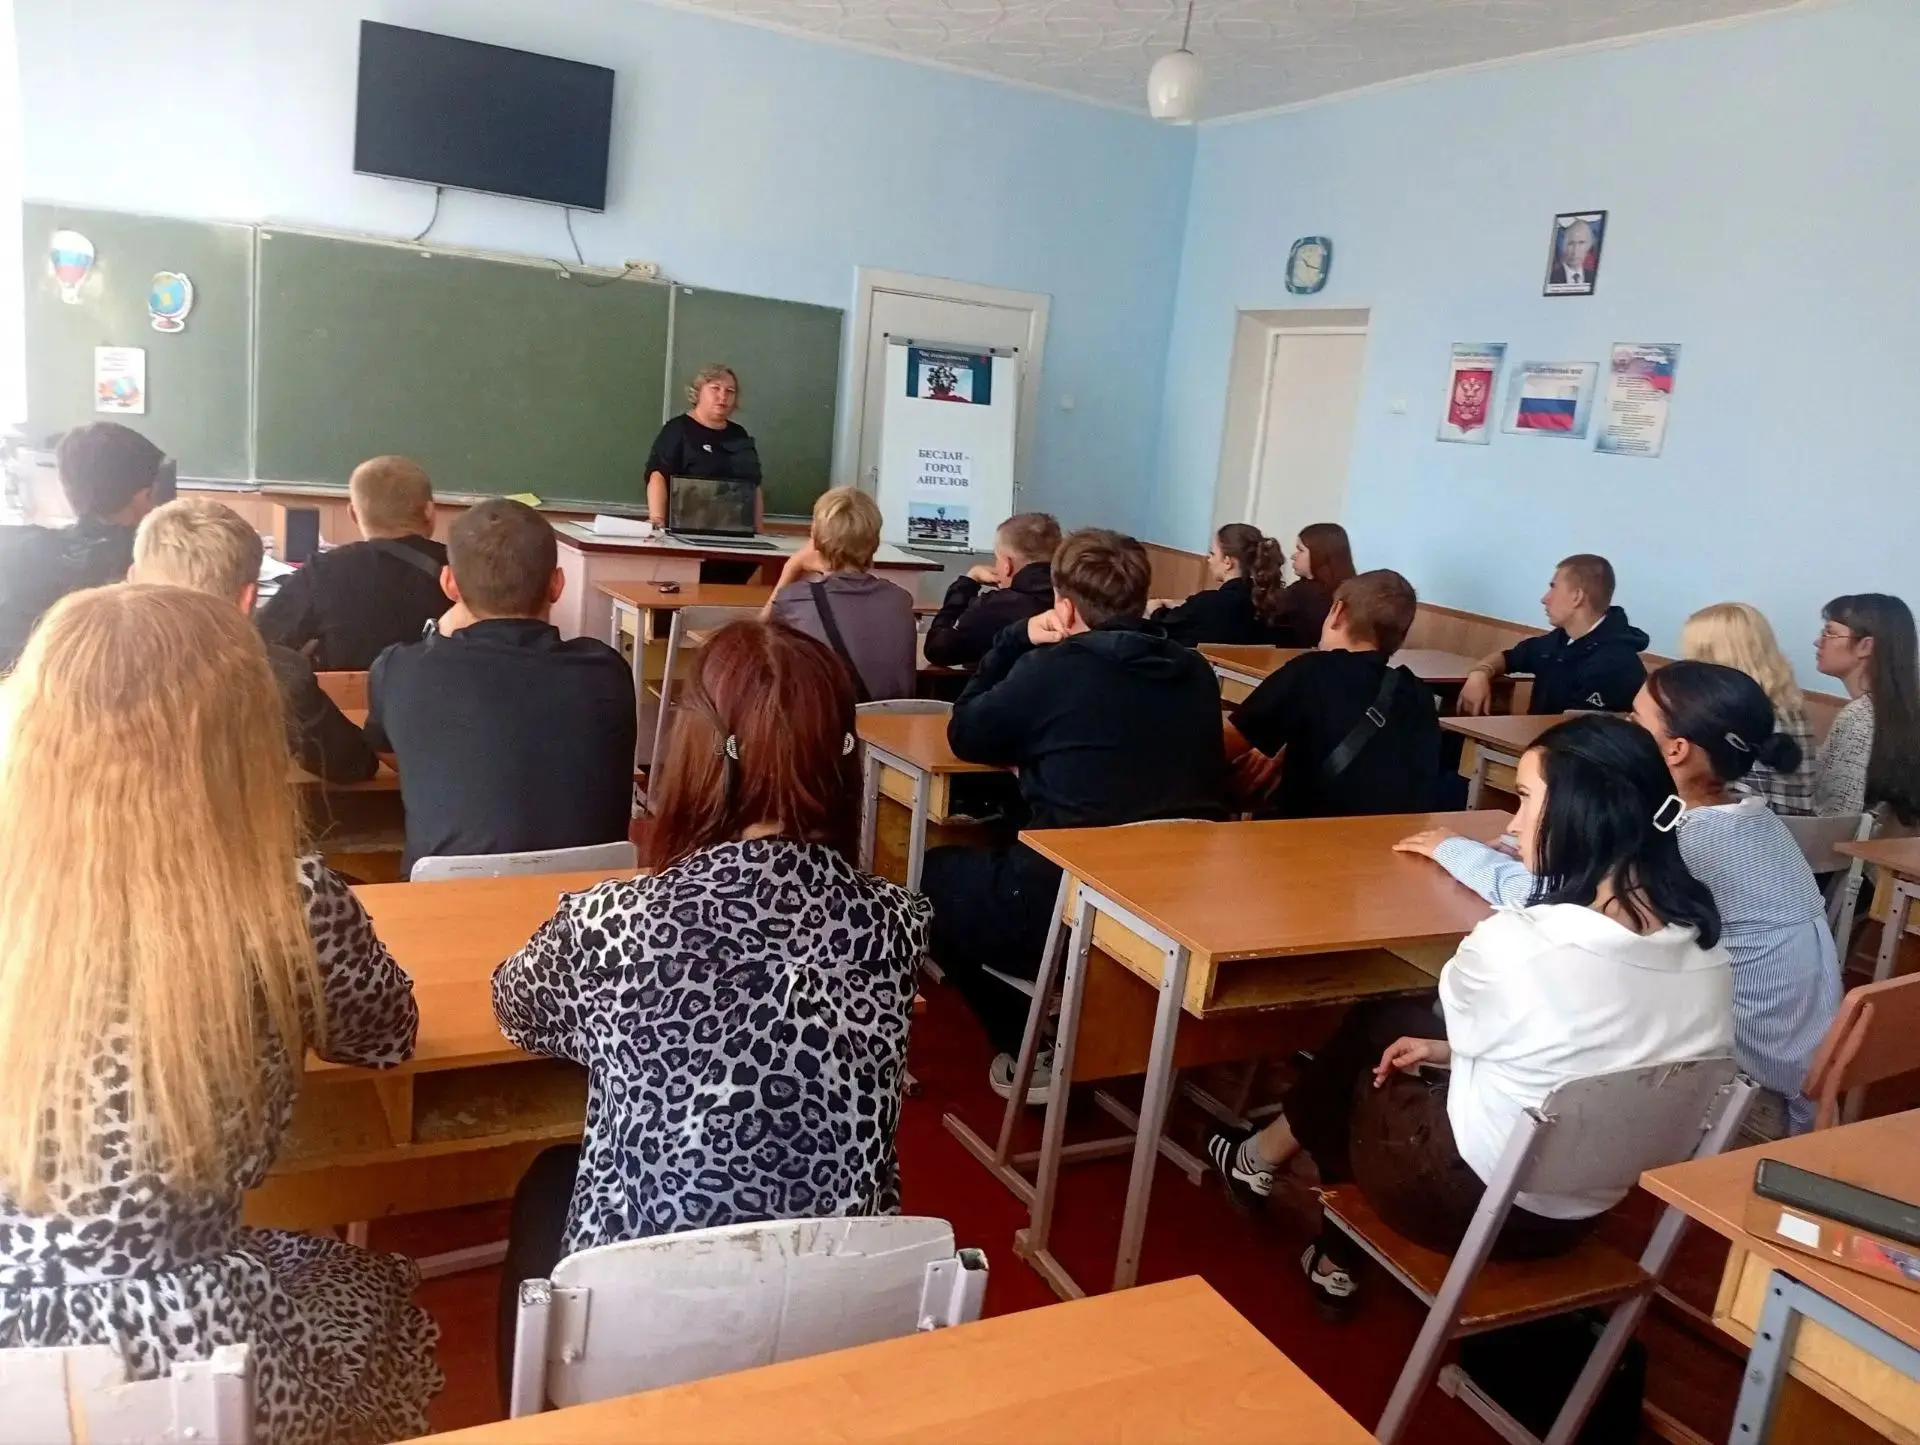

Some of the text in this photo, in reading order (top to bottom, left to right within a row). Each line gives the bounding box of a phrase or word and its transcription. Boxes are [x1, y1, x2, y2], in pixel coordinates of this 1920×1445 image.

[918, 449, 963, 460] БЕСЛАН
[925, 462, 961, 474] ГОРОД
[917, 476, 969, 487] АНГЕЛОВ
